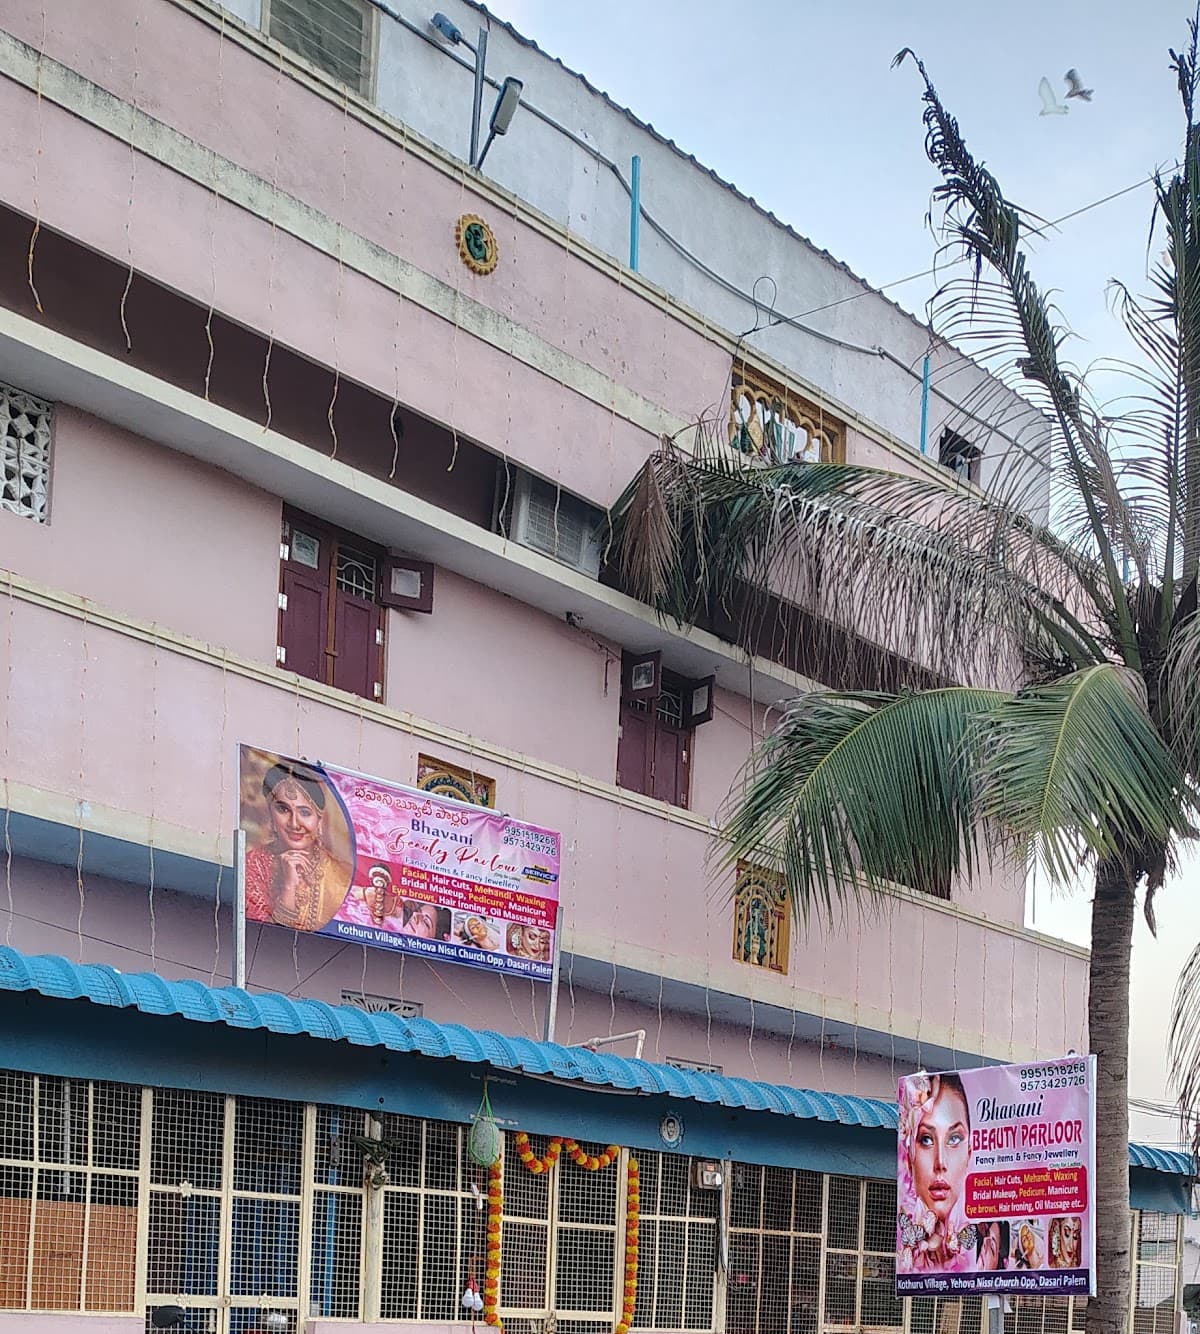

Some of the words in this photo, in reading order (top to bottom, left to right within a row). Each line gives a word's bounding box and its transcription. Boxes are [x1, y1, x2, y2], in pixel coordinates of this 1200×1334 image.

[386, 827, 449, 864] Beauty
[411, 818, 473, 846] Bhavani
[503, 836, 556, 856] 9573429726
[405, 856, 428, 870] Fancy
[452, 867, 460, 876] &
[461, 870, 483, 883] Fancy
[485, 875, 520, 891] Jewellery
[401, 877, 428, 890] Bridal
[429, 883, 467, 901] Makeup,
[468, 892, 507, 909] Pedicure,
[508, 902, 547, 918] Manicure
[402, 867, 430, 882] Facial,
[431, 874, 450, 887] Hair
[451, 878, 473, 893] Cuts,
[474, 884, 514, 902] Mehandi,
[515, 893, 546, 909] Waxing
[391, 885, 408, 898] Eye
[409, 889, 437, 904] brows,
[439, 895, 457, 907] Hair
[490, 906, 502, 917] Oil
[503, 910, 537, 926] Massage
[338, 923, 373, 940] Kothuru
[374, 929, 406, 949] Village,
[407, 935, 437, 953] Yehova
[438, 943, 458, 957] Nissi
[458, 948, 486, 963] Church
[486, 953, 506, 968] Opp,
[507, 958, 531, 972] Dasari
[1020, 1075, 1085, 1092] 9573429726
[976, 1094, 1044, 1122] Bhavani
[972, 1125, 1017, 1152] BEAUTY
[1021, 1120, 1082, 1147] PARLOOR
[975, 1155, 995, 1166] Fancy
[1016, 1153, 1021, 1161] &
[1023, 1151, 1041, 1161] Fancy
[1044, 1148, 1079, 1161] Jewellery
[972, 1190, 992, 1200] Bridal
[992, 1188, 1018, 1200] Makeup,
[1047, 1185, 1079, 1195] Manicure
[974, 1176, 993, 1188] Facial,
[994, 1175, 1006, 1185] Hair
[1007, 1174, 1023, 1186] Cuts,
[1053, 1171, 1078, 1182] Waxing
[966, 1205, 977, 1215] Eye
[998, 1203, 1011, 1212] Hair
[1034, 1200, 1043, 1210] Oil
[1044, 1199, 1070, 1211] Massage
[897, 1278, 924, 1290] Kothuru
[924, 1277, 949, 1291] Village,
[950, 1277, 975, 1289] Yehova
[976, 1277, 994, 1288] Nissi
[994, 1276, 1019, 1288] Church
[1020, 1276, 1038, 1290] Opp,
[1039, 1274, 1063, 1287] Dasari
[1063, 1274, 1087, 1287] Palem
